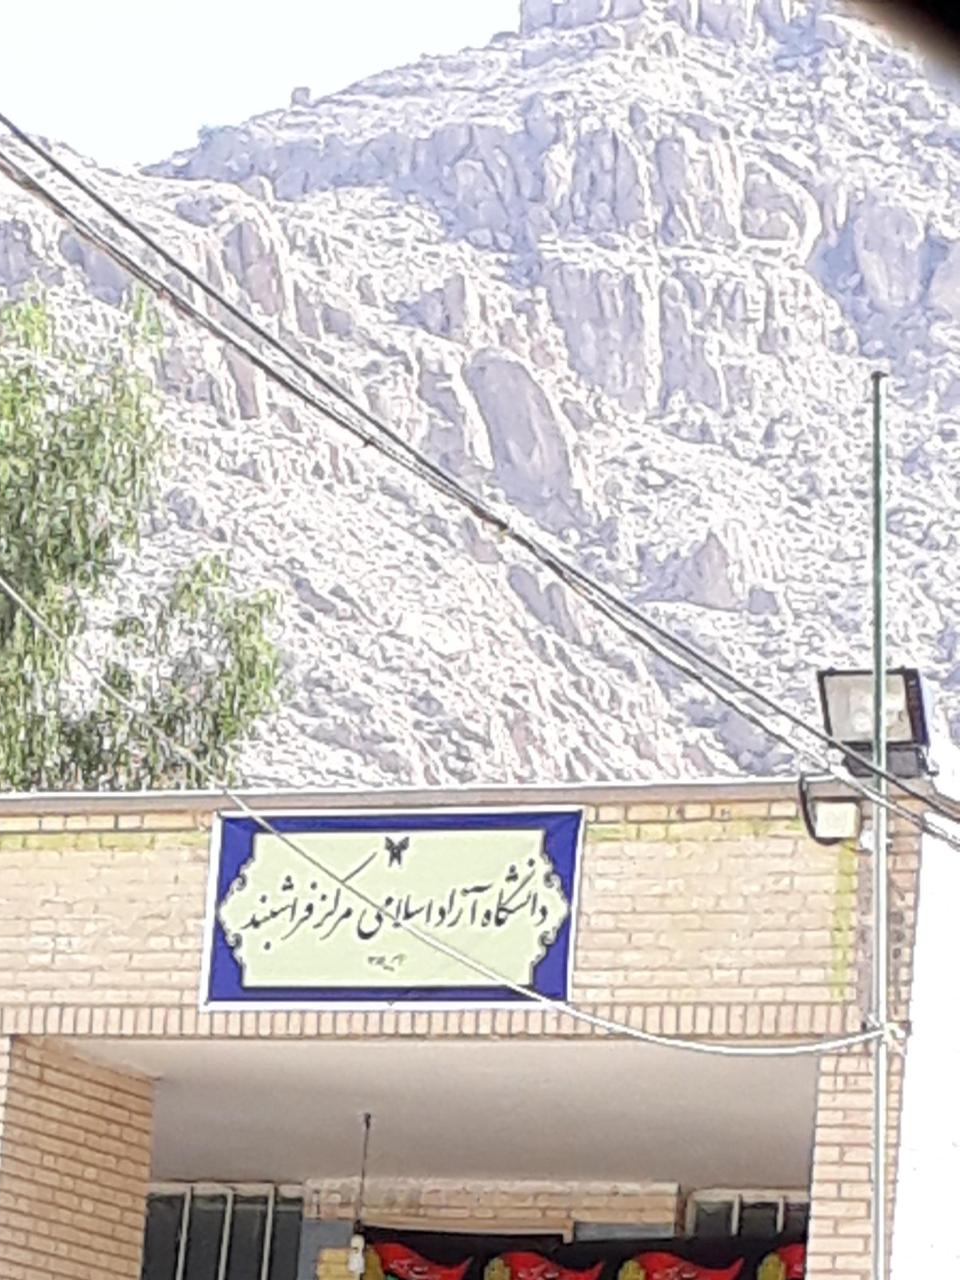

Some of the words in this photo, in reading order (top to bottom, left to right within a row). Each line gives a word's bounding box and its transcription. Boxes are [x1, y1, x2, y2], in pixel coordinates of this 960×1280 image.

[240, 873, 316, 952] فراشبند
[313, 851, 378, 941] مرکز
[356, 893, 432, 941] اسلامی
[438, 883, 494, 928] آزاد
[480, 858, 549, 929] دانشگاه
